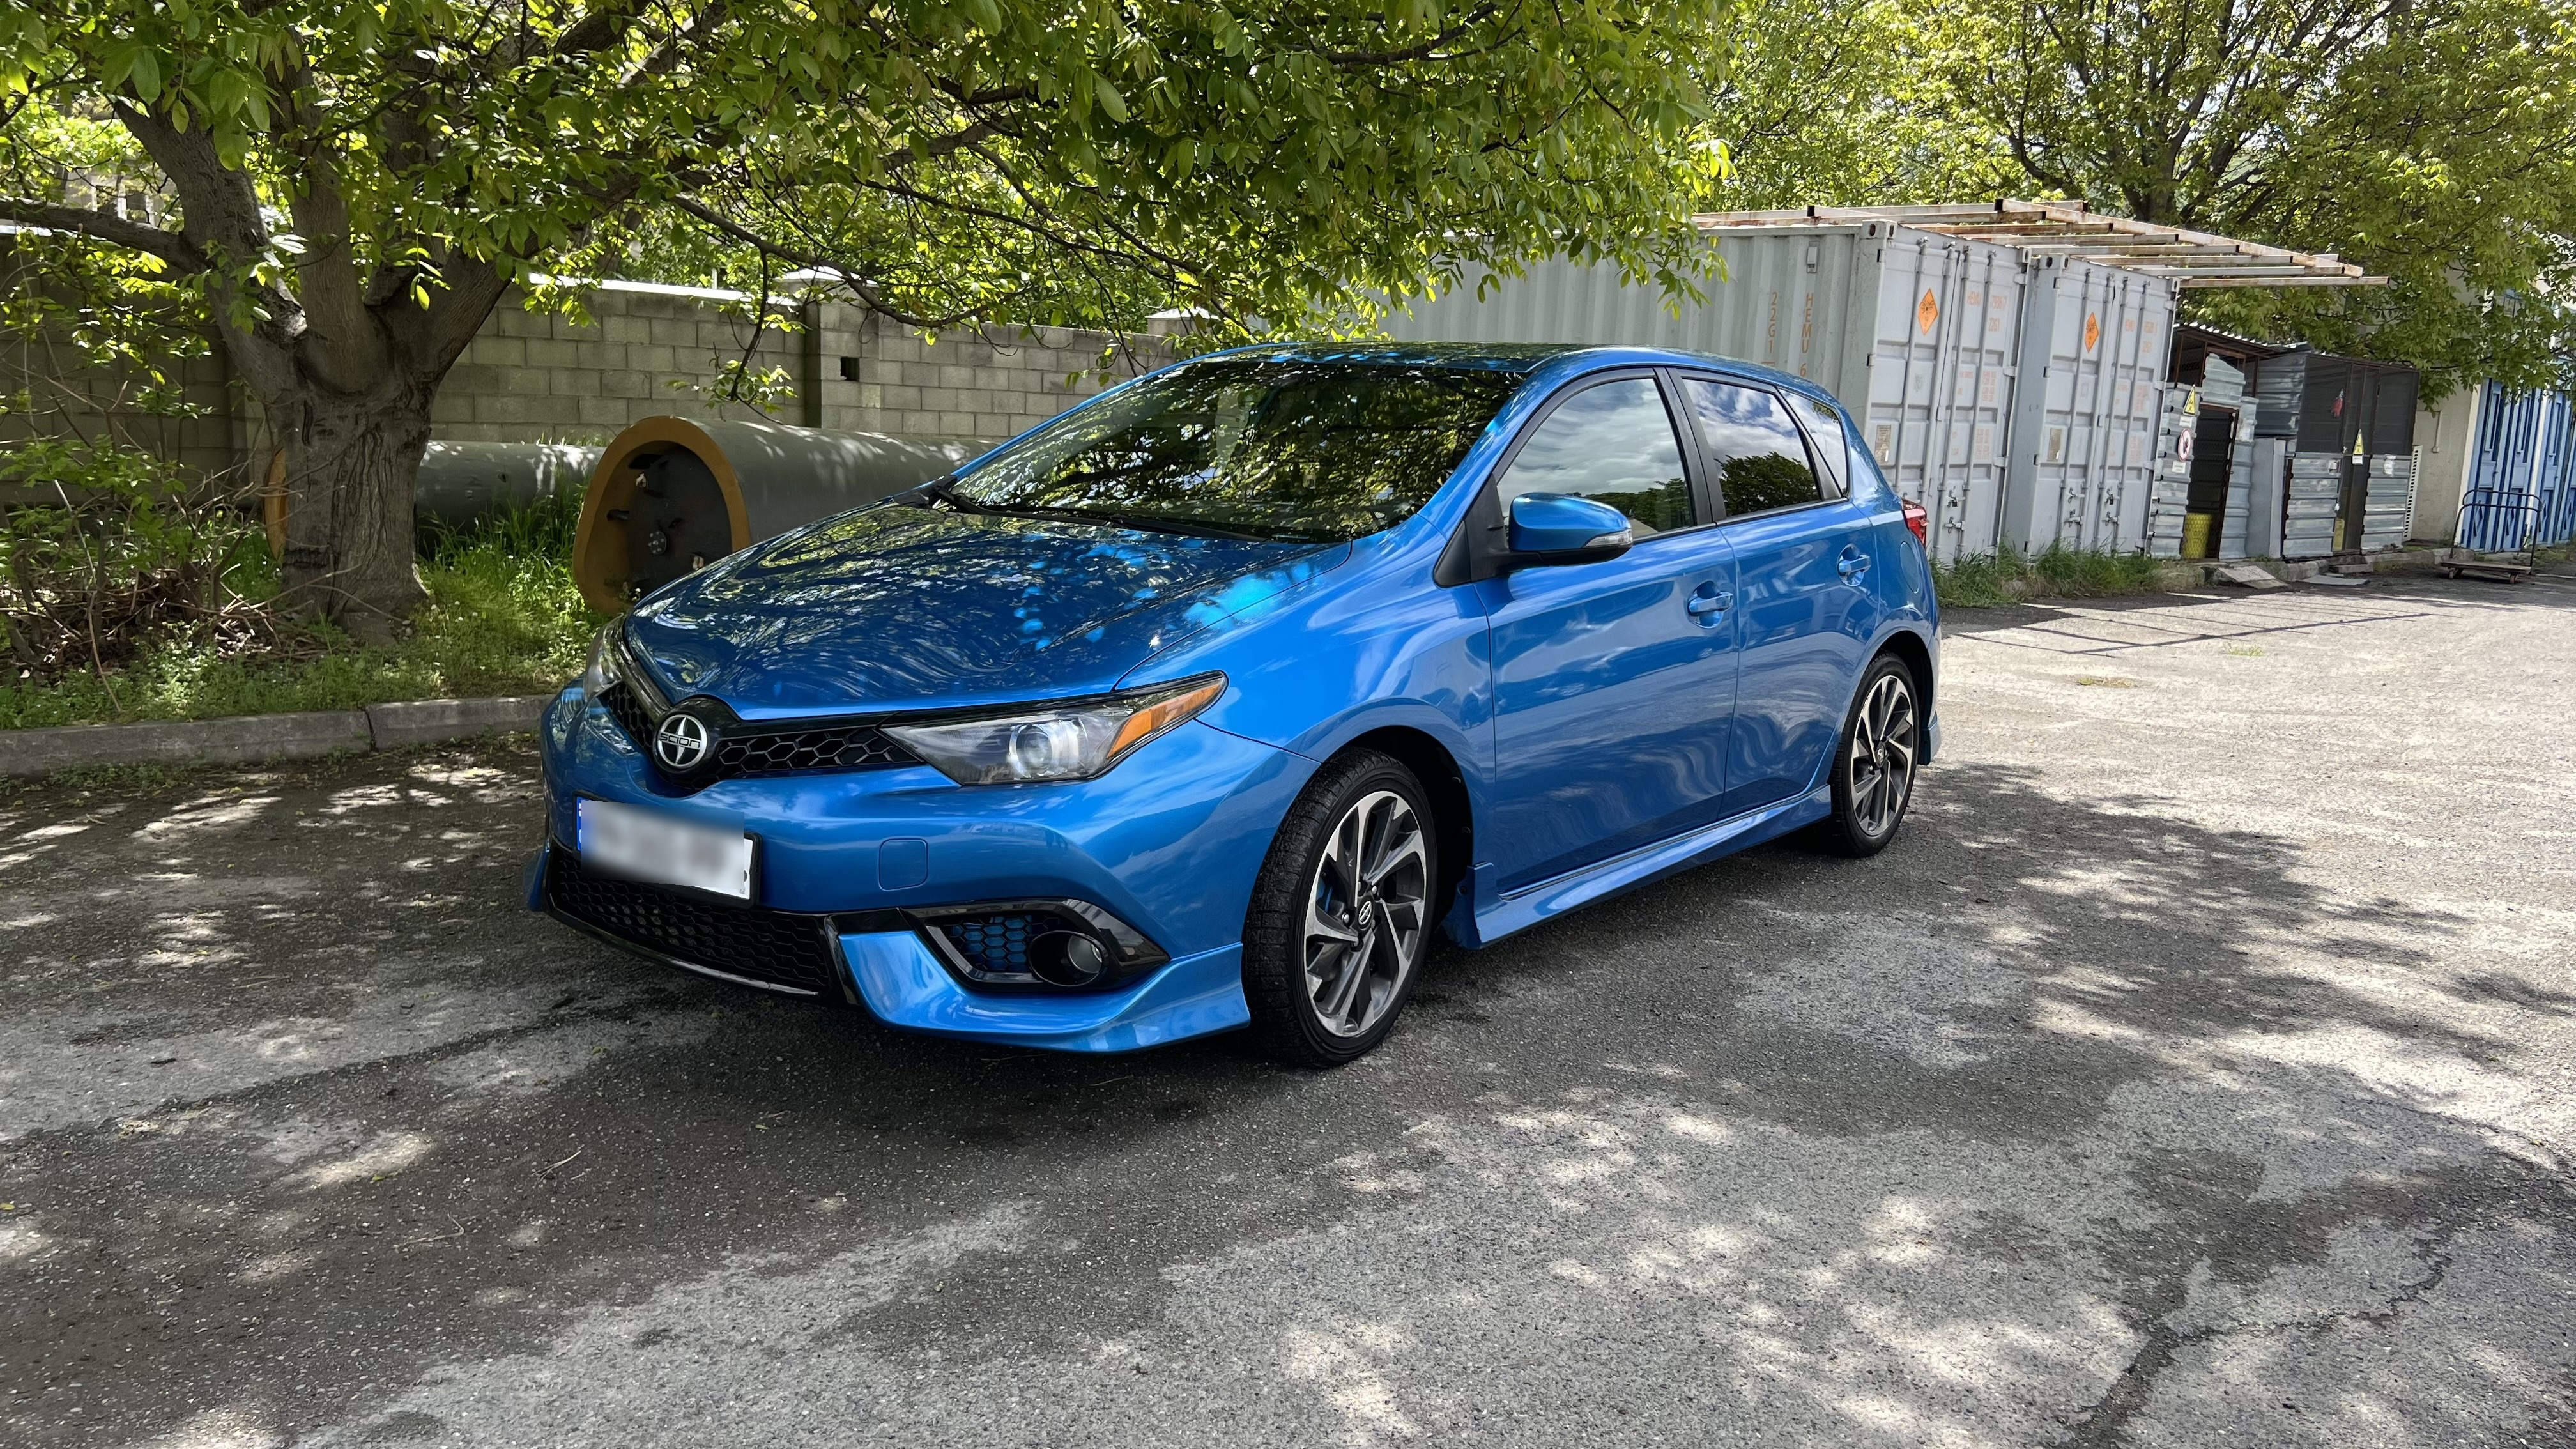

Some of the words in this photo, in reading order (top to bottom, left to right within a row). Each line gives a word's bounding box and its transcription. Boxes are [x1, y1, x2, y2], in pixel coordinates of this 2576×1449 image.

[1768, 291, 1777, 354] 22G1
[1802, 292, 1814, 353] HEMU
[660, 733, 701, 749] SCION
